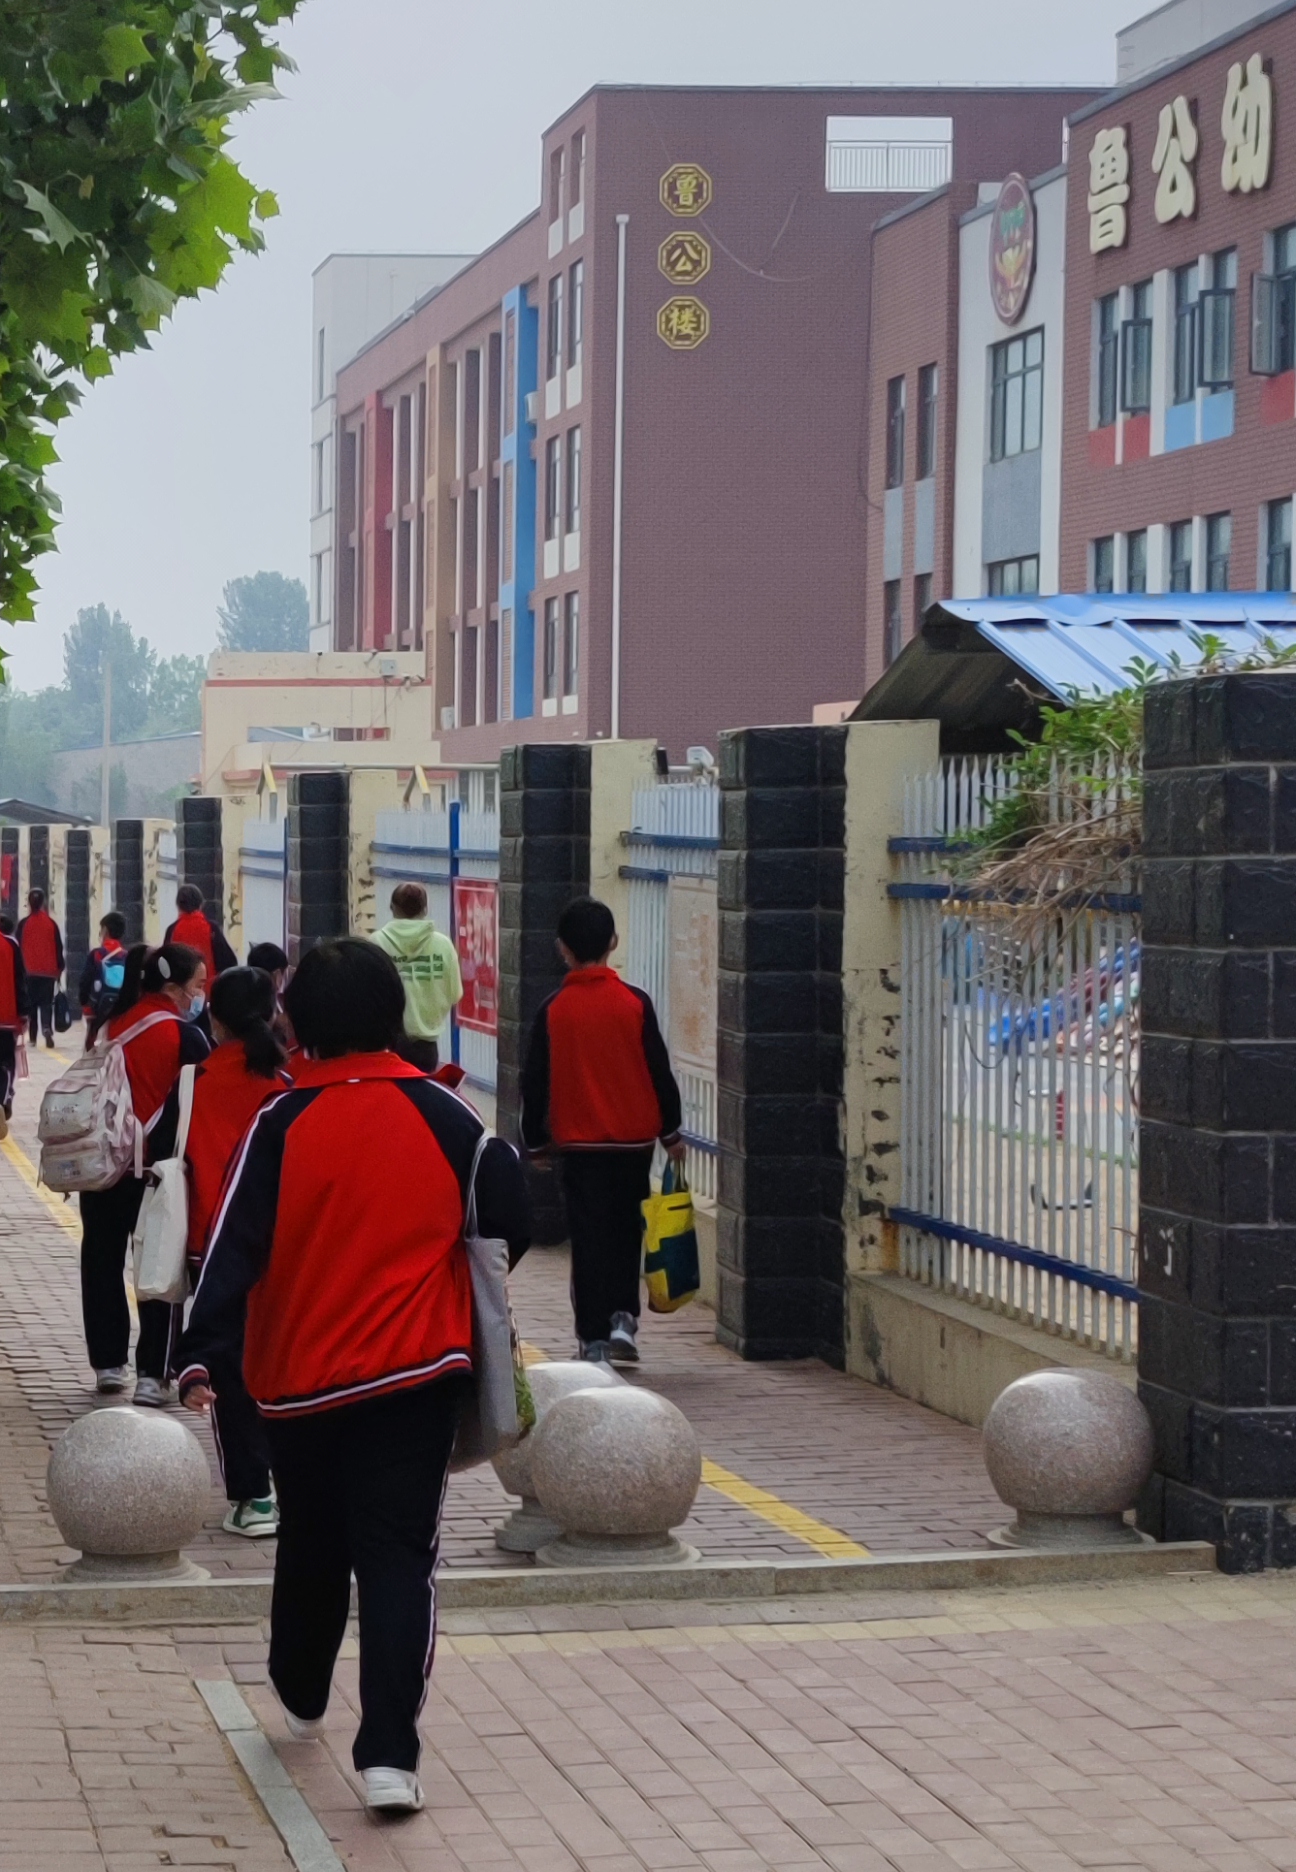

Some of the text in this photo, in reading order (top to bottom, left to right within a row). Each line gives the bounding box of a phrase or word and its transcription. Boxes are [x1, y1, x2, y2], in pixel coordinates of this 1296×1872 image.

[1087, 52, 1271, 254] 鲁公幼
[666, 173, 702, 341] 鲁公楼
